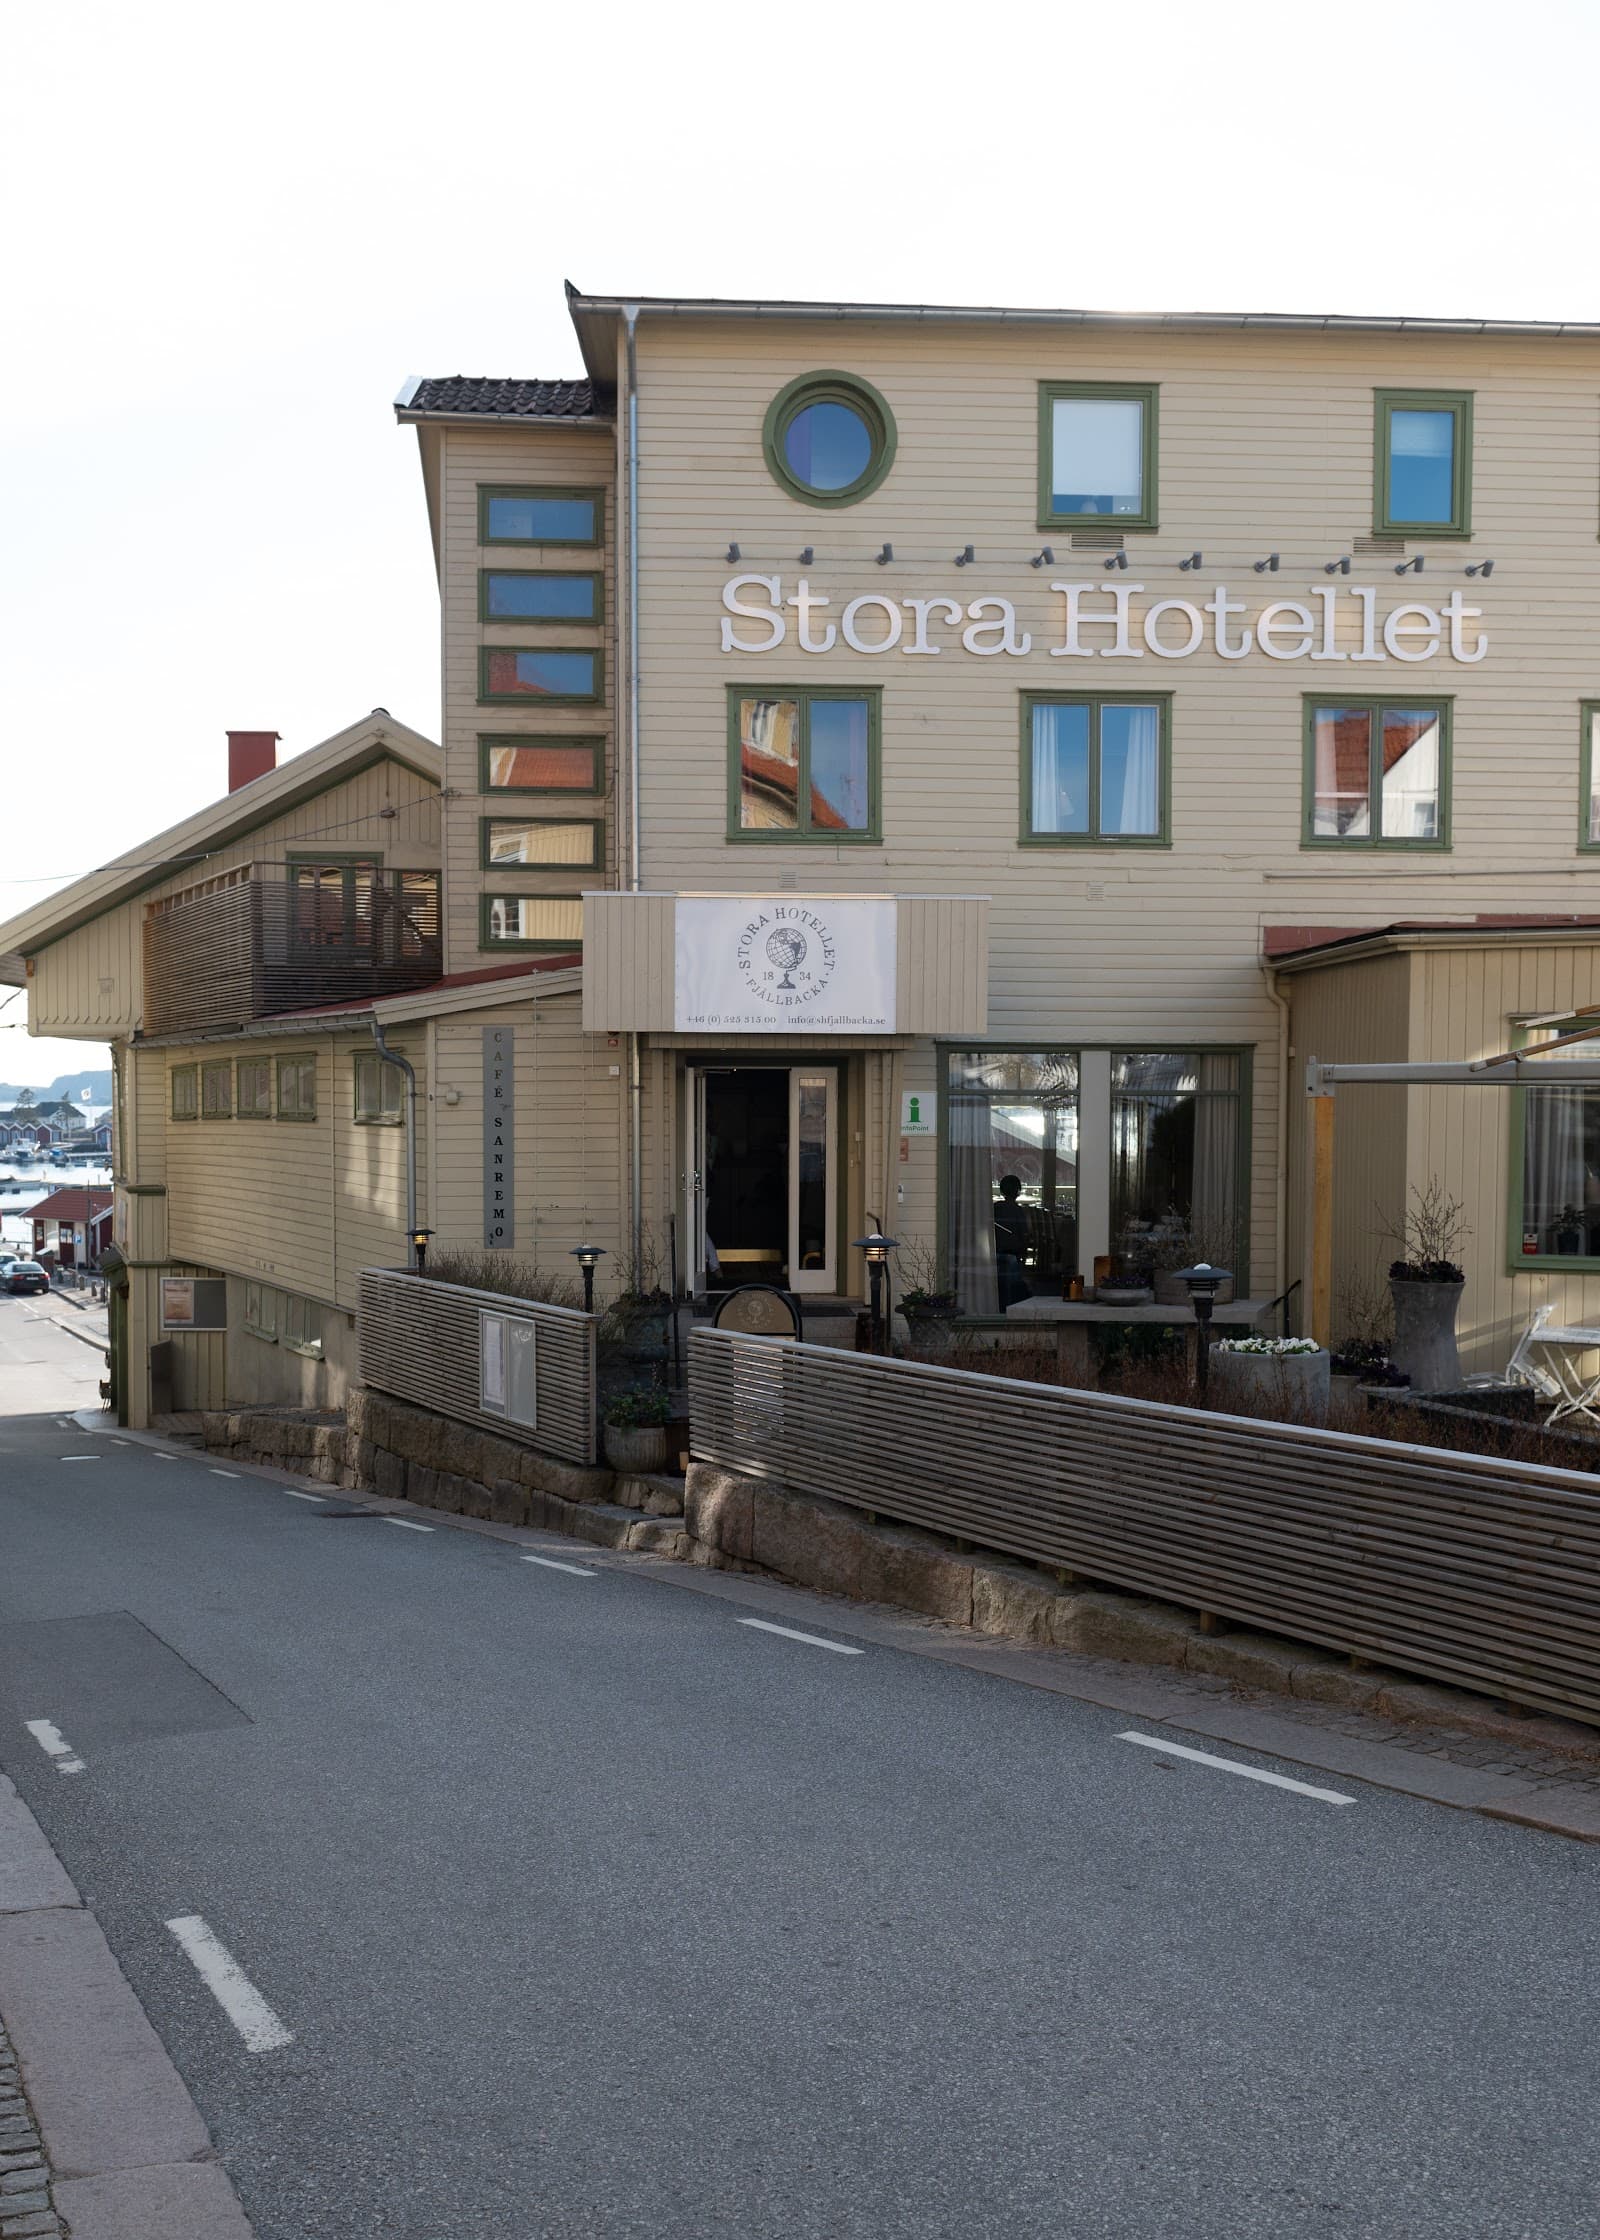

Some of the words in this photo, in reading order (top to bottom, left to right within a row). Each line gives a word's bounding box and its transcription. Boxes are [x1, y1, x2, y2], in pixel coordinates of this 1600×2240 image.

[720, 573, 1032, 657] Stora
[1050, 582, 1488, 665] Hotellet
[737, 914, 770, 970] STORA
[775, 907, 836, 971] HOTELLET
[763, 971, 774, 981] 18
[799, 971, 811, 981] 34
[687, 1015, 705, 1023] +46
[707, 1014, 721, 1026] (0)
[723, 1015, 741, 1023] 525
[764, 1016, 777, 1024] 00
[787, 1015, 887, 1027] info@shfjallbacka.se
[493, 1031, 504, 1099] CAFÉ
[493, 1117, 505, 1237] SANREMO
